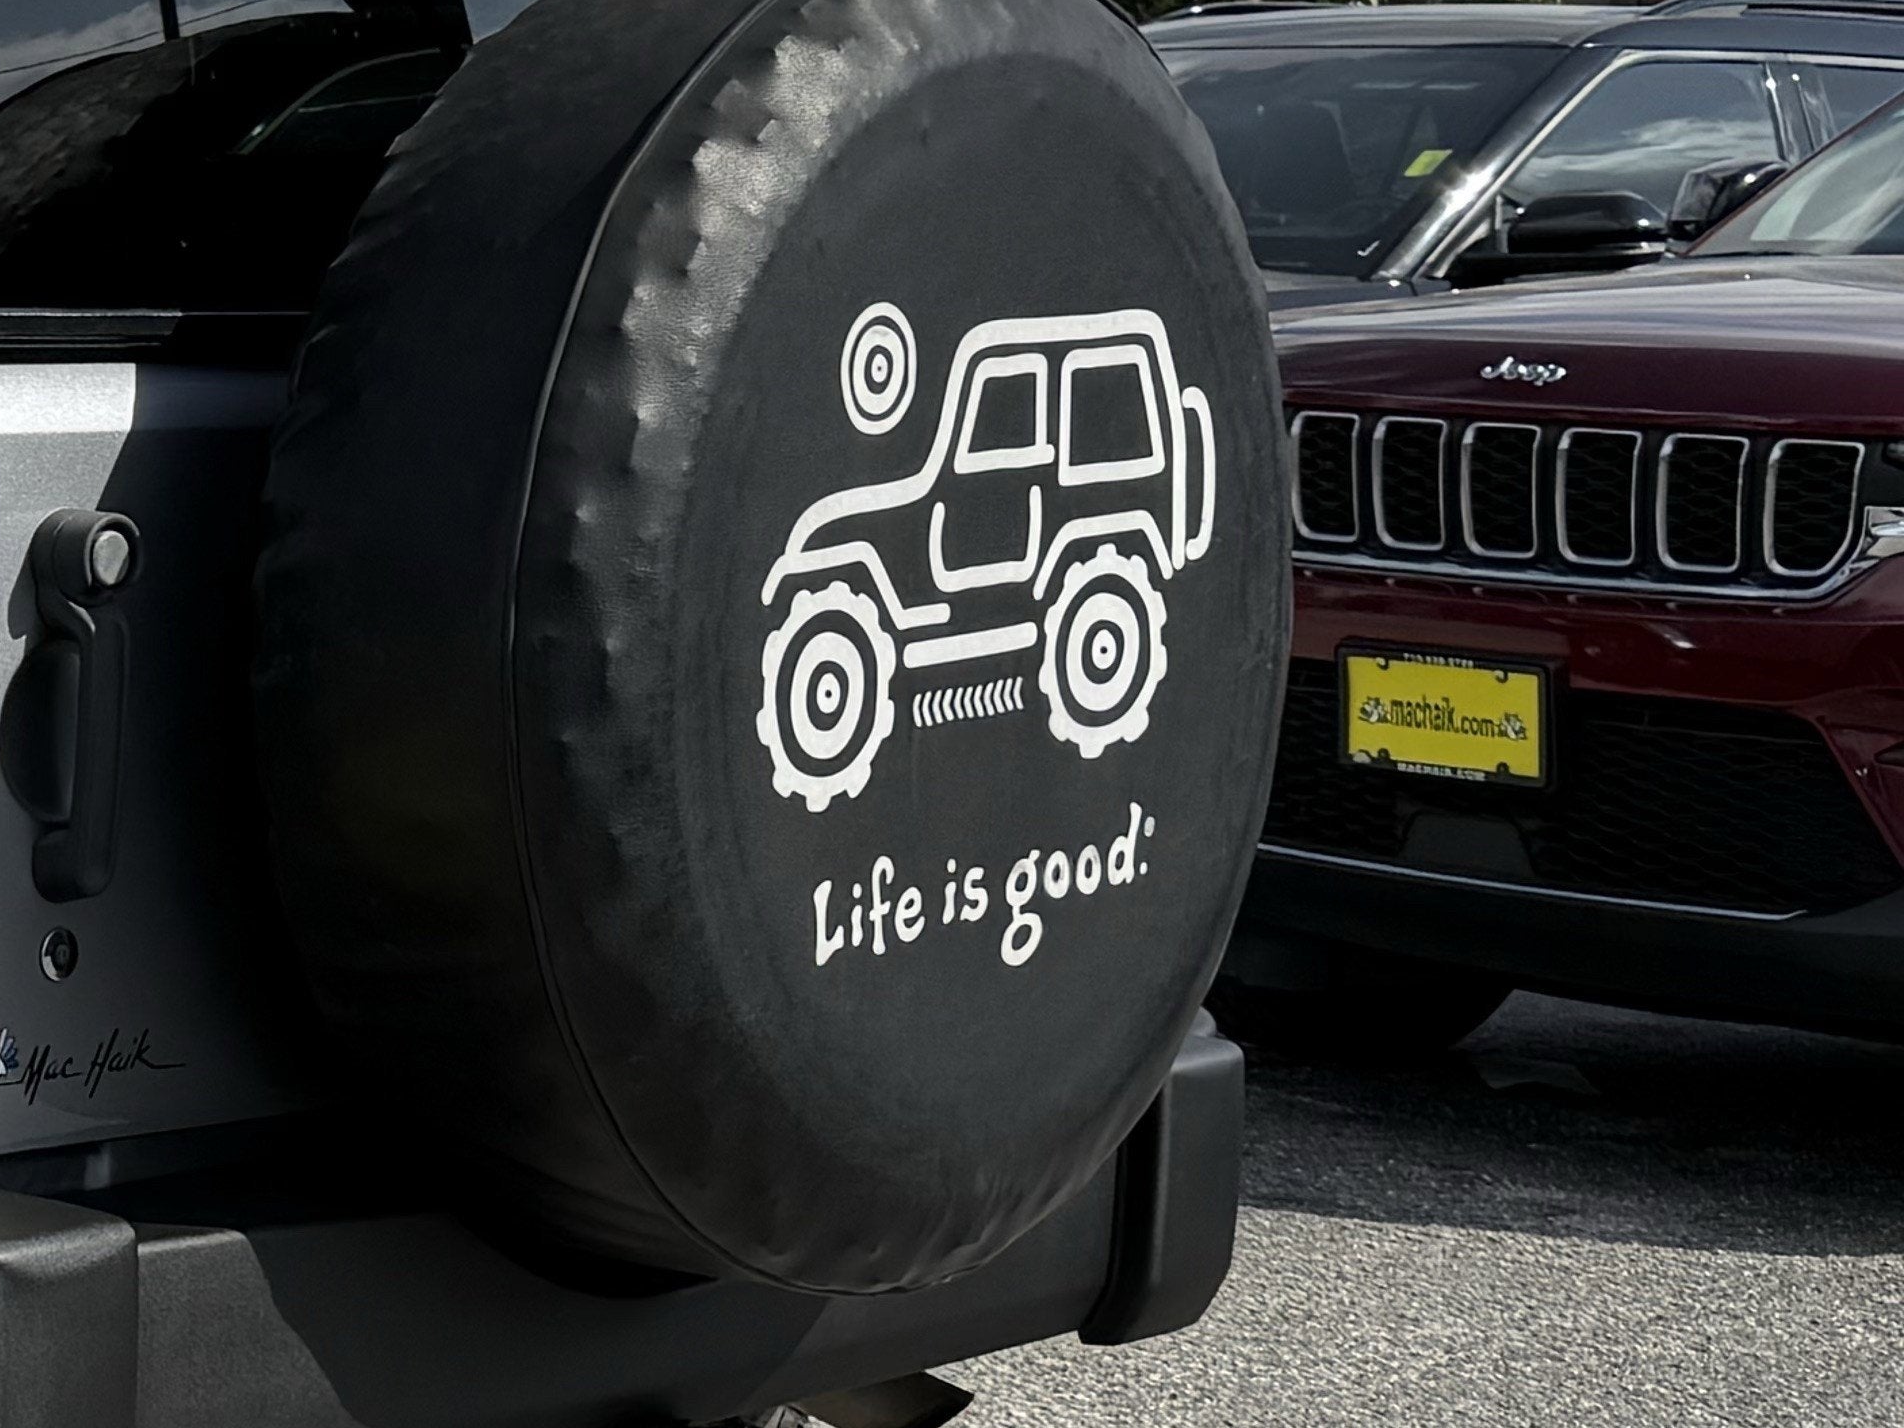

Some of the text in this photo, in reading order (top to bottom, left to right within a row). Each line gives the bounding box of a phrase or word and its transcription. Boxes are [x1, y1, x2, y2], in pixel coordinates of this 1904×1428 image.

[1480, 355, 1567, 387] Jeep
[812, 855, 925, 966] Life
[942, 858, 989, 926] is
[88, 1029, 186, 1099] Haik
